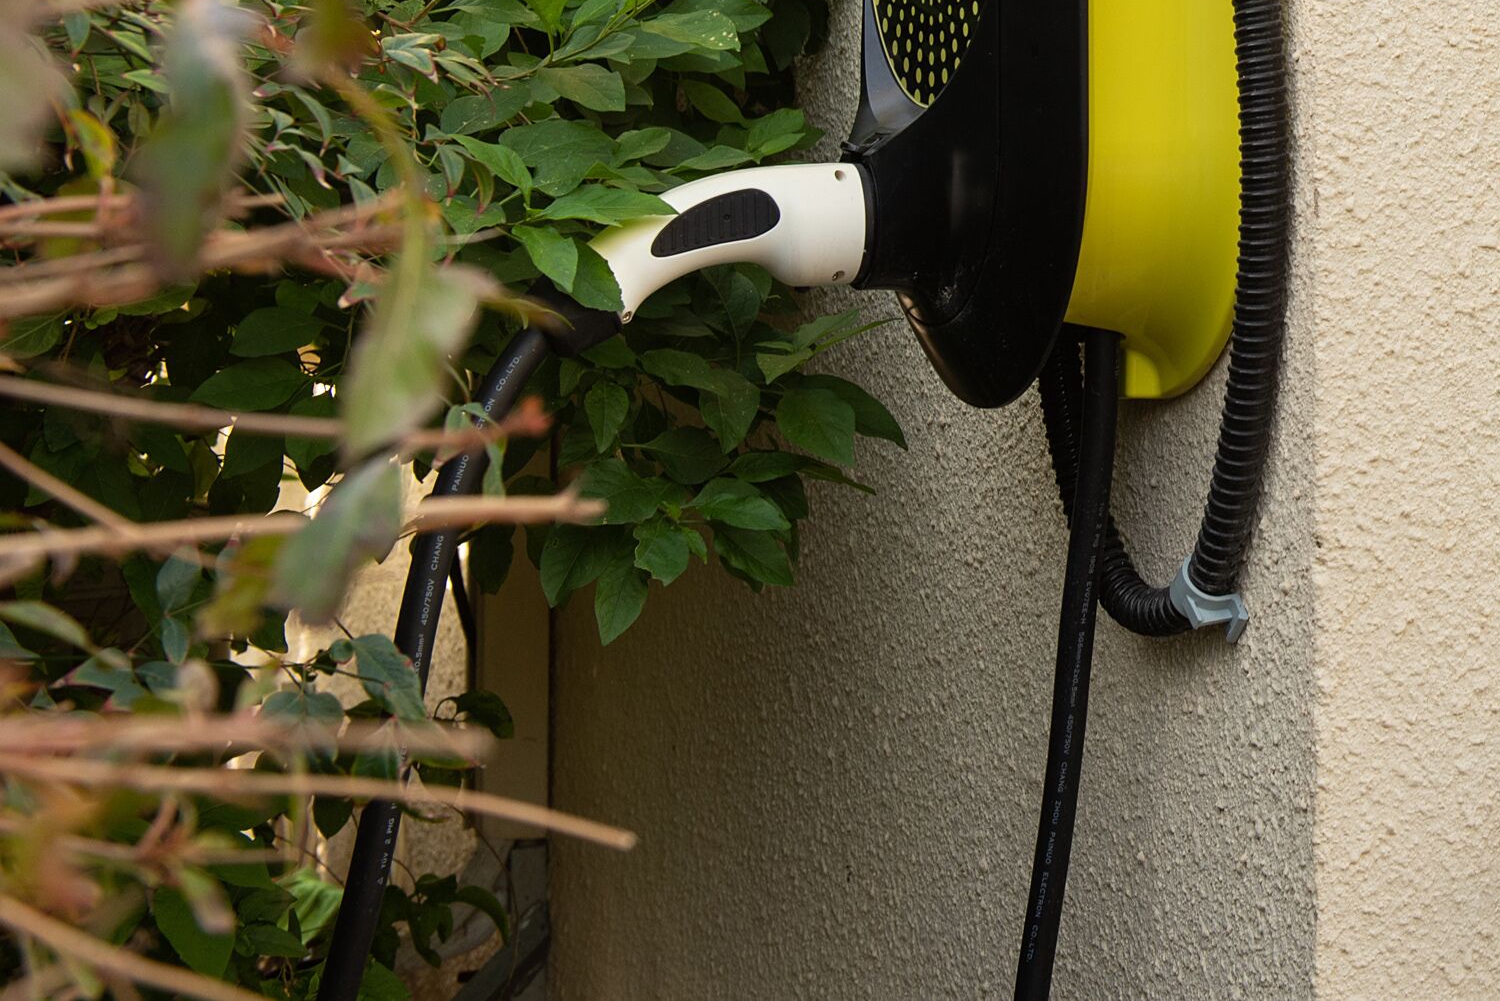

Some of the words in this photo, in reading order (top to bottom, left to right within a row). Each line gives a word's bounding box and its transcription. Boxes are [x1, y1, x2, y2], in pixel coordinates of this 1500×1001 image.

[421, 578, 435, 626] 450/750V
[430, 534, 444, 571] CHANG
[451, 454, 470, 492] PAINUO
[1063, 714, 1075, 755] 450/750V
[1057, 761, 1068, 794] CHANG
[1051, 800, 1062, 825] ZHOU
[1044, 831, 1057, 865] PAINUO
[1034, 871, 1049, 918] ELECTRON
